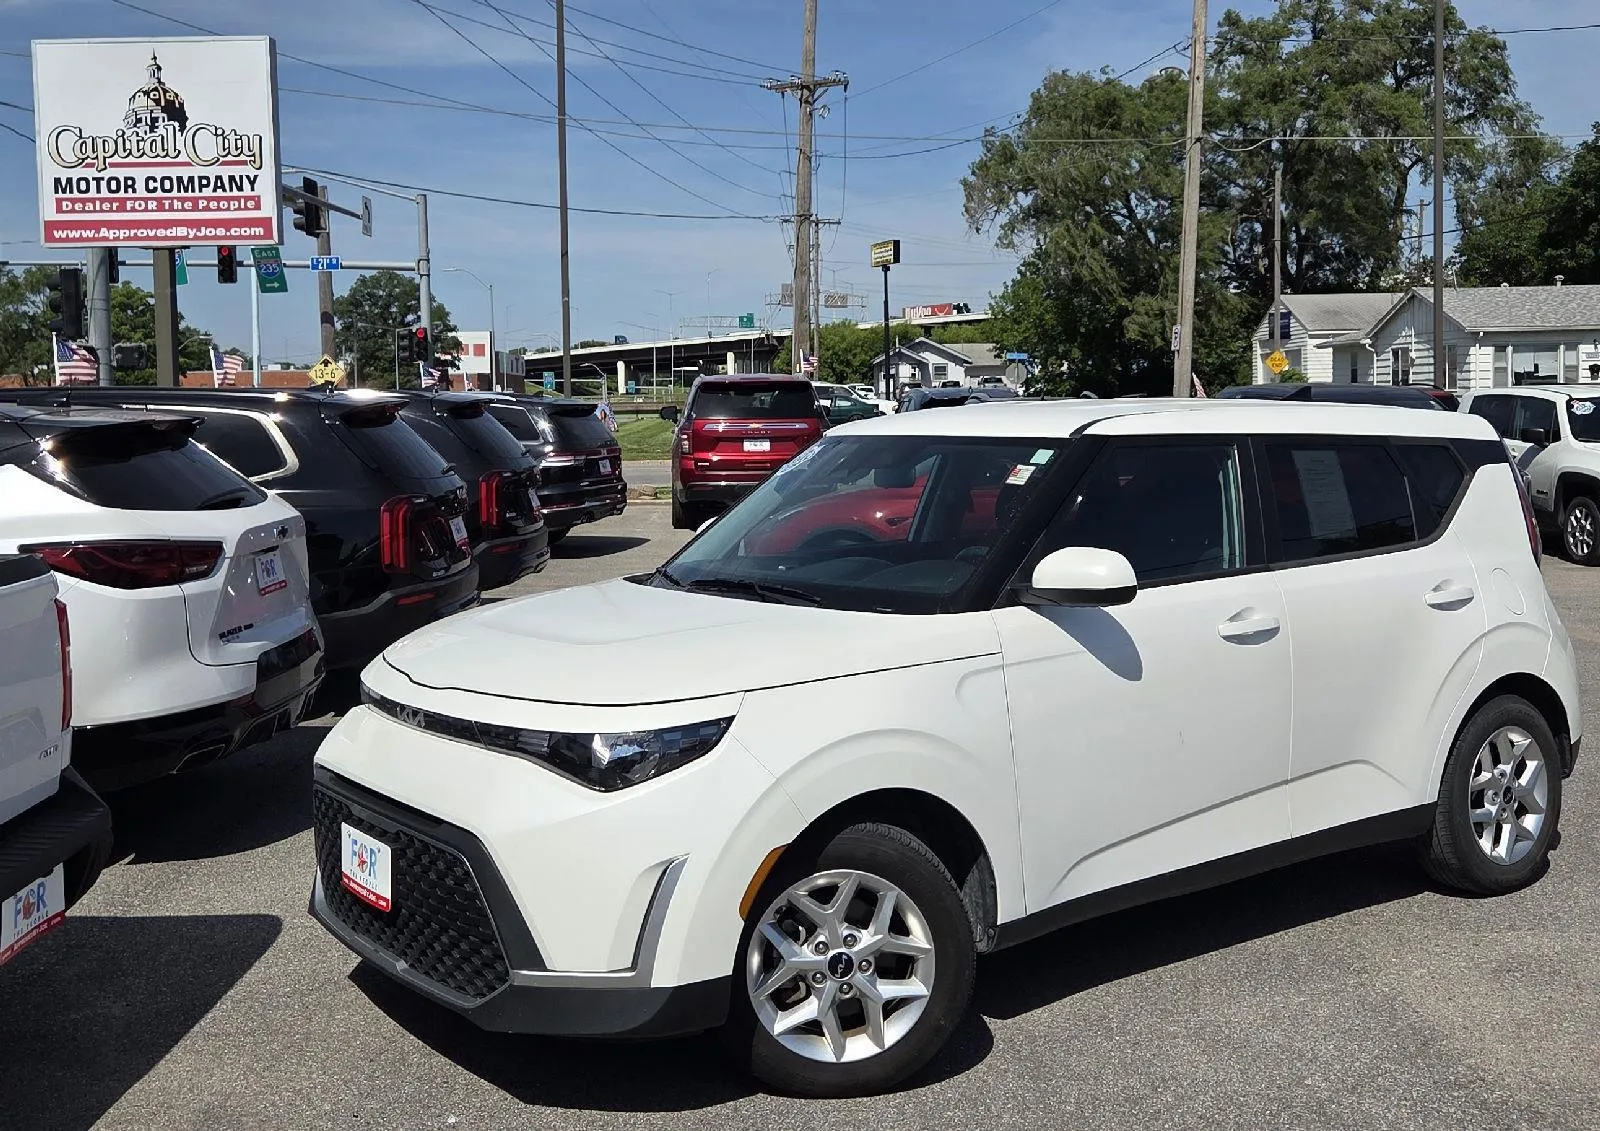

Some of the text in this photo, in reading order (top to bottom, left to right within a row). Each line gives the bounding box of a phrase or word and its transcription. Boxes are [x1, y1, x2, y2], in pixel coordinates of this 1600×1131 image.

[47, 123, 263, 172] Capital City
[54, 174, 260, 195] MOTOR COMPANY
[61, 199, 256, 211] Dealer FOR The People
[53, 226, 265, 240] www.ApprovedByJoe.com
[260, 263, 279, 273] 235
